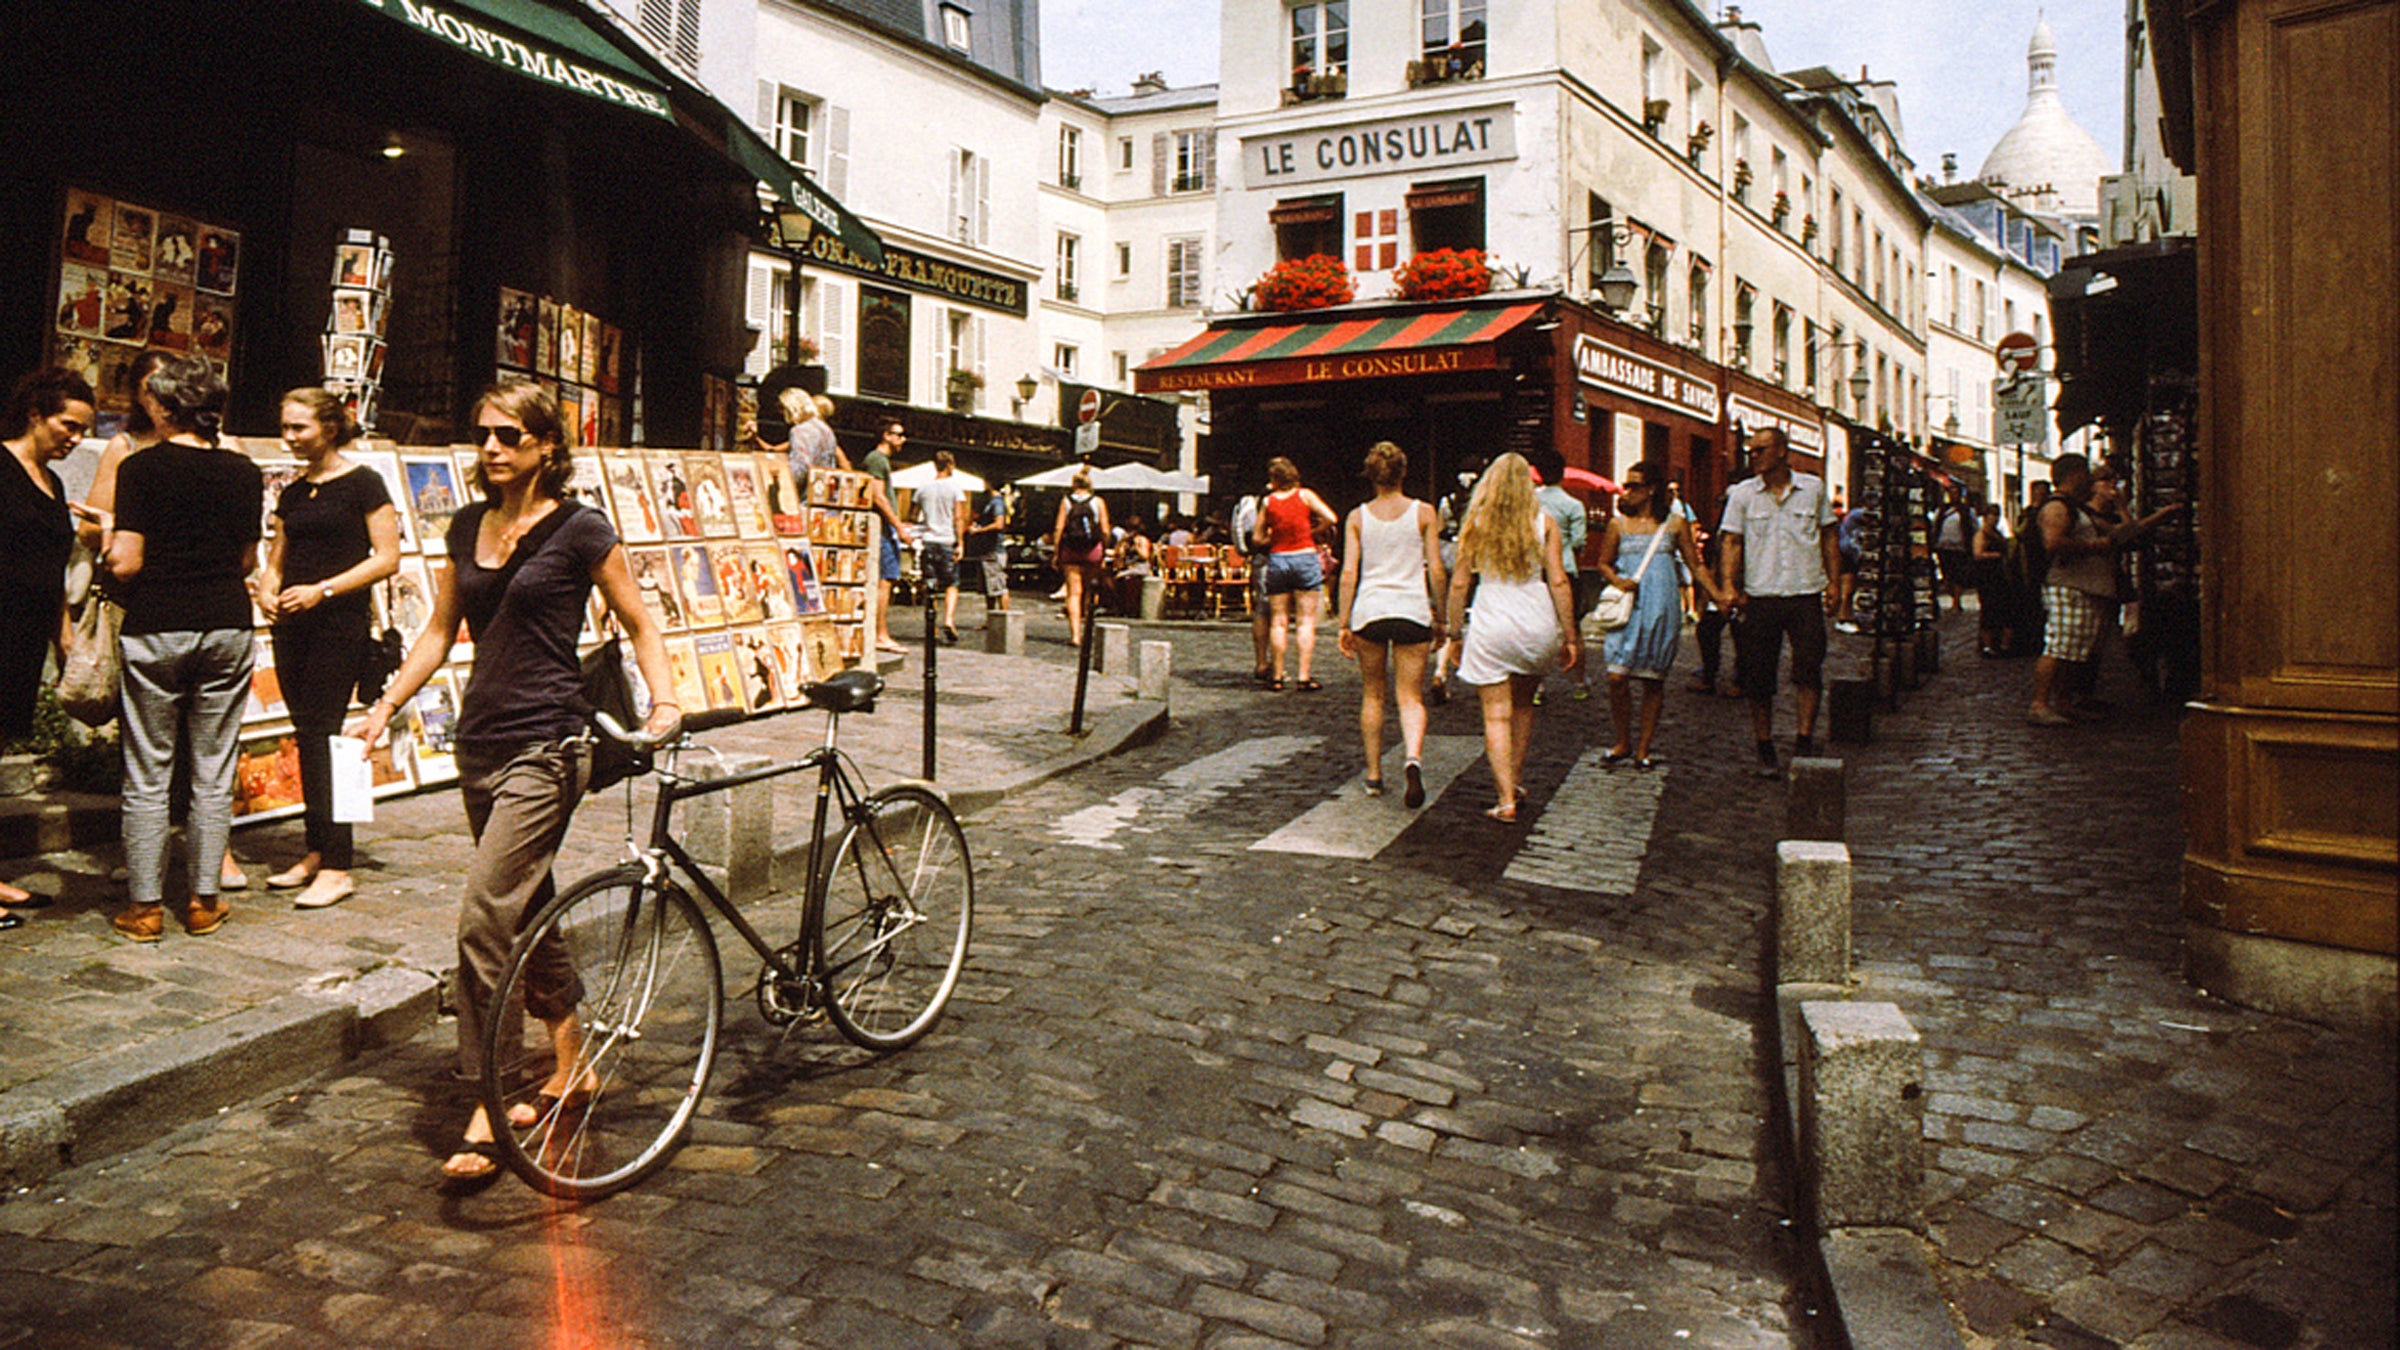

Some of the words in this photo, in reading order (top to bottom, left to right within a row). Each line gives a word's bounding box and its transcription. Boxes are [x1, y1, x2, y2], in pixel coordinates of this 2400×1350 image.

[399, 0, 667, 116] MONTMARTRE
[1263, 143, 1295, 176] LE
[1316, 117, 1493, 170] CONSULAT
[791, 180, 842, 236] GALERIE
[884, 252, 1017, 307] FRANQUETTE
[1159, 369, 1257, 389] RESTAURANT
[1306, 363, 1333, 381] LE
[1342, 352, 1463, 378] CONSULAT
[1580, 346, 1656, 393] AMBASSADE
[1662, 373, 1677, 400] DE
